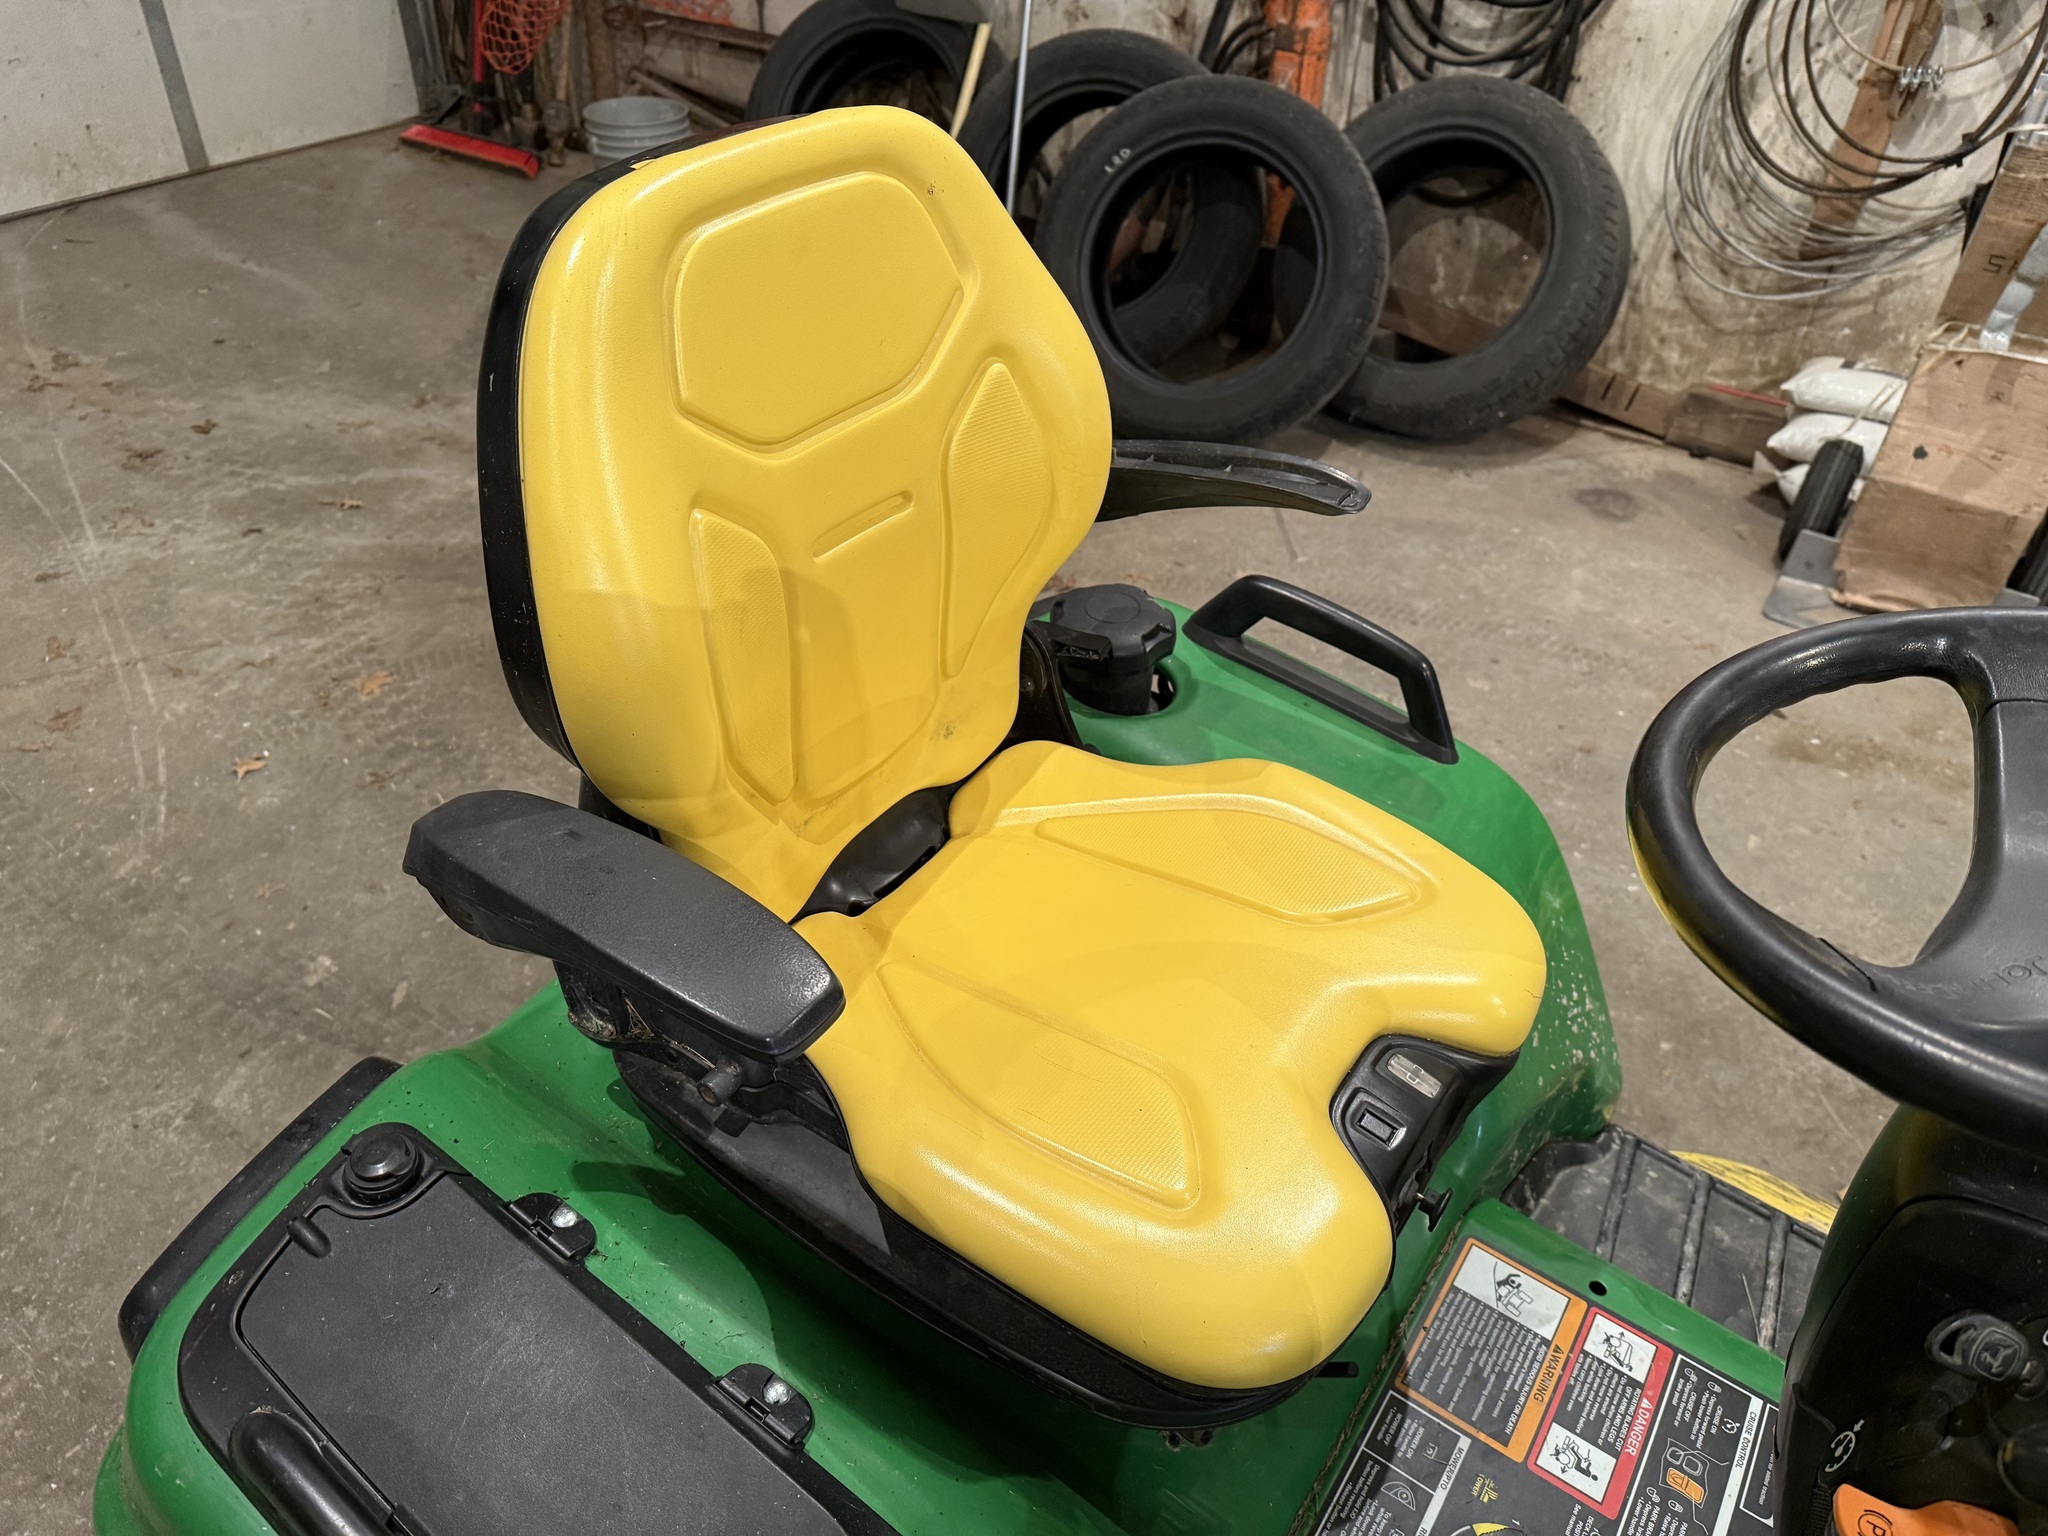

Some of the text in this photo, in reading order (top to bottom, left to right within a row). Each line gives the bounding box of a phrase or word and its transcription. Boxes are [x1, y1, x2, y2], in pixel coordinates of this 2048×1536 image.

[1516, 1351, 1524, 1363] and
[1521, 1349, 1534, 1373] operator's
[1511, 1361, 1520, 1375] down
[1525, 1360, 1540, 1385] SERIOUS
[1513, 1372, 1525, 1391] manual
[1533, 1354, 1561, 1403] WARNING
[1619, 1376, 1627, 1385] Do
[1499, 1391, 1507, 1402] not
[1517, 1384, 1530, 1405] INJURY
[1587, 1390, 1595, 1401] and
[1598, 1384, 1606, 1397] mow
[1612, 1392, 1620, 1406] mow
[1671, 1378, 1685, 1406] brake pedal
[1700, 1391, 1710, 1405] Push
[1491, 1399, 1503, 1418] across
[1512, 1404, 1522, 1415] OR
[1581, 1399, 1592, 1418] behind
[1588, 1401, 1600, 1421] reverse
[1607, 1404, 1616, 1419] when
[1607, 1385, 1633, 1443] OFF ARMS AND LEGS
[1673, 1382, 1693, 1427] Depress forward or
[1683, 1391, 1697, 1423] CRUISE OFF
[1696, 1404, 1705, 1419] lower
[1383, 1412, 1403, 1446] MOWER OFF
[1504, 1413, 1518, 1435] DEATH
[1575, 1416, 1586, 1434] before
[1614, 1387, 1642, 1452] ROTATING BLADES CUT
[1691, 1417, 1701, 1435] button
[1695, 1395, 1717, 1450] Depress forward pedal
[1709, 1405, 1723, 1435] CRUISE ON
[1597, 1437, 1603, 1446] or
[1624, 1408, 1650, 1456] DANGER
[1734, 1411, 1757, 1468] CRUISE CONTROL
[1405, 1426, 1425, 1459] MOWER ON
[1365, 1463, 1381, 1486] Depress
[1440, 1446, 1464, 1490] MOWER/PTO
[1763, 1470, 1771, 1487] added
[1360, 1484, 1369, 1497] and
[1758, 1485, 1768, 1505] traction
[1354, 1515, 1363, 1528] and
[1360, 1501, 1378, 1532] Look down
[1374, 1507, 1385, 1523] while
[1383, 1511, 1392, 1519] To
[1564, 1503, 1582, 1536] See manual
[1626, 1498, 1645, 1536] Lower handle
[1639, 1503, 1652, 1527] Depress
[1649, 1504, 1661, 1523] PARK
[1660, 1514, 1672, 1532] Raise
[1326, 1521, 1332, 1530] or
[1376, 1518, 1388, 1534] keep
[1583, 1515, 1594, 1533] DECK
